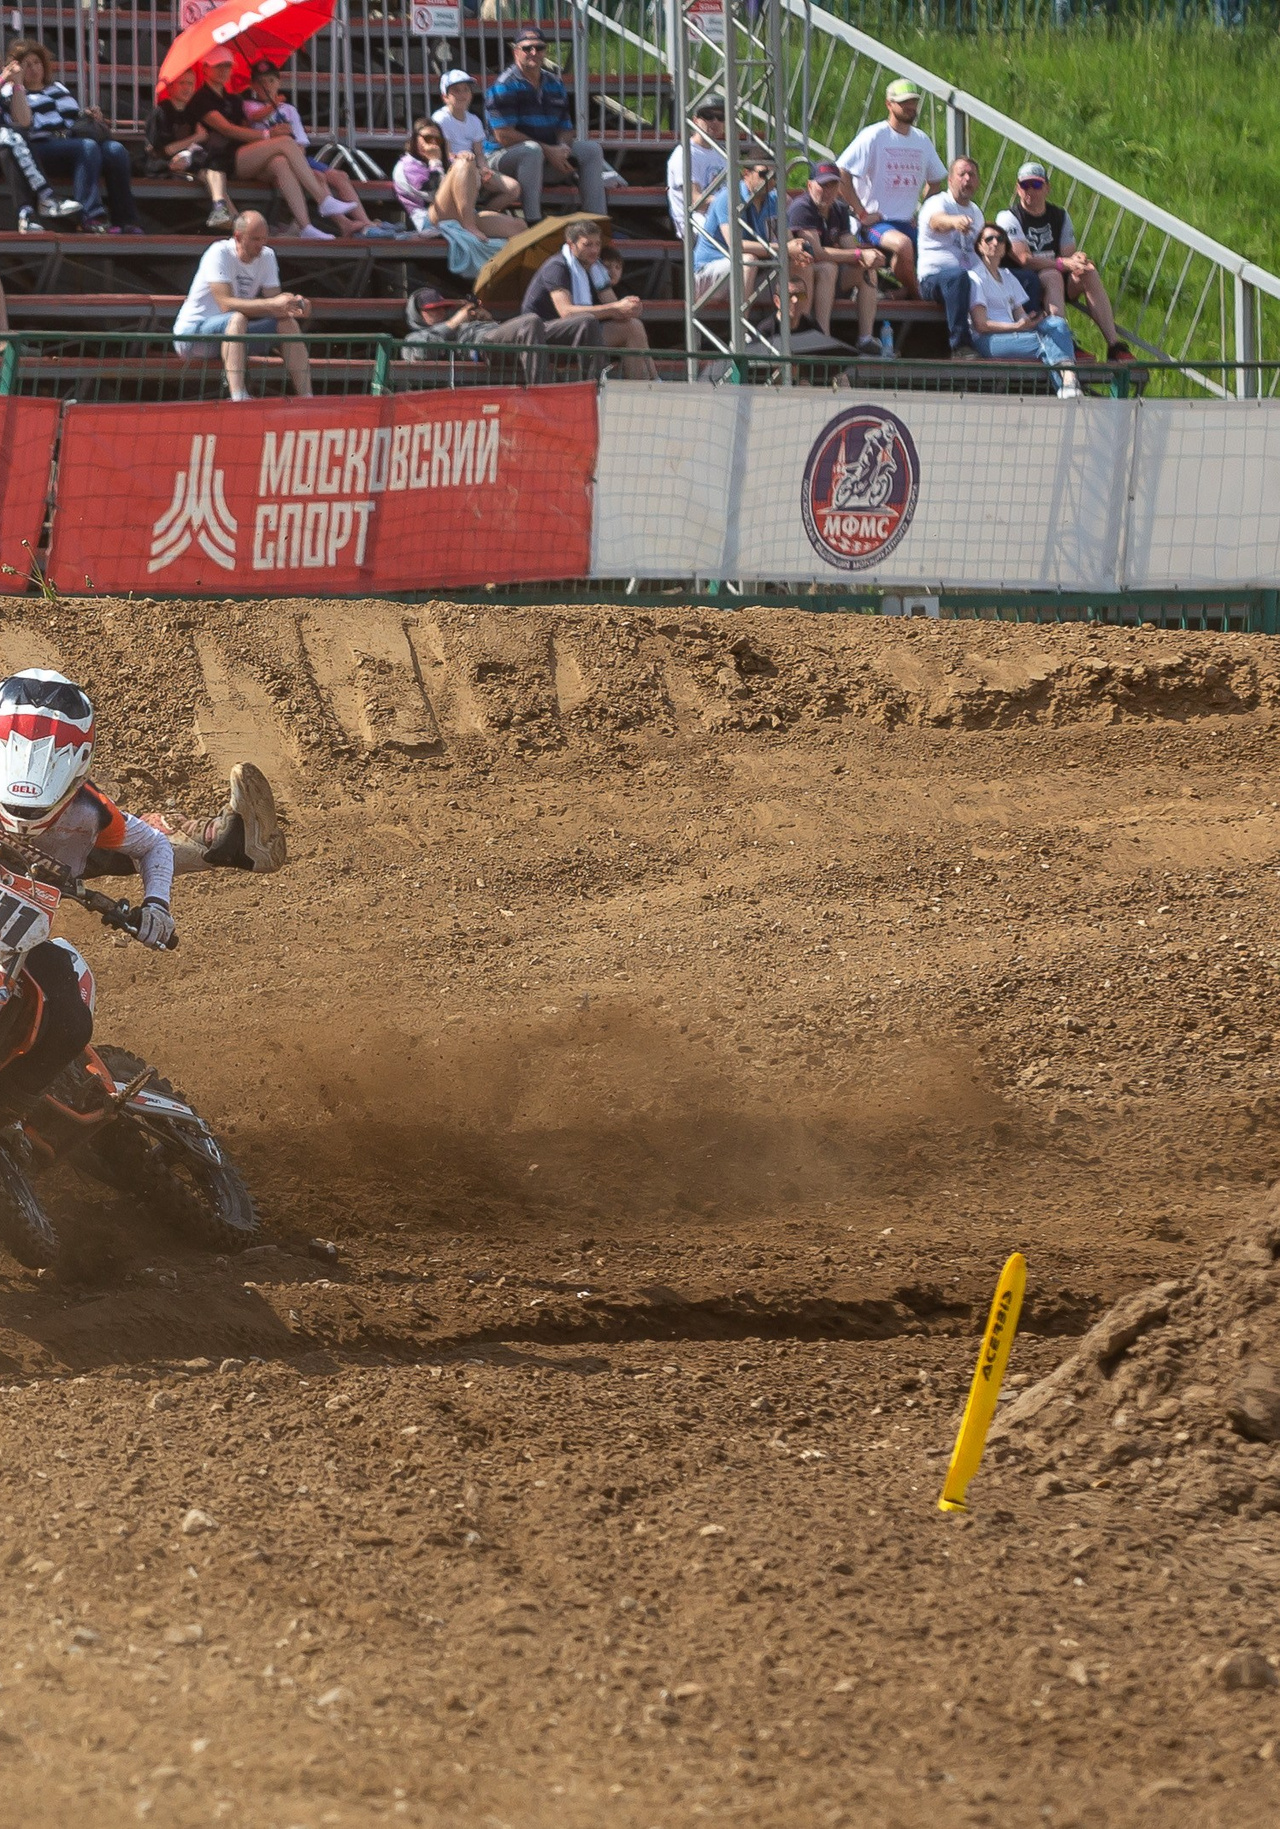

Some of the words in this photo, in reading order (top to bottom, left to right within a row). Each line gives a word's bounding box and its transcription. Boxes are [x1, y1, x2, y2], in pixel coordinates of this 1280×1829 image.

[259, 404, 500, 497] МОСКОВСКИЙ
[253, 500, 376, 571] СПОРТ
[823, 515, 890, 539] МФМС
[11, 784, 39, 795] BELL
